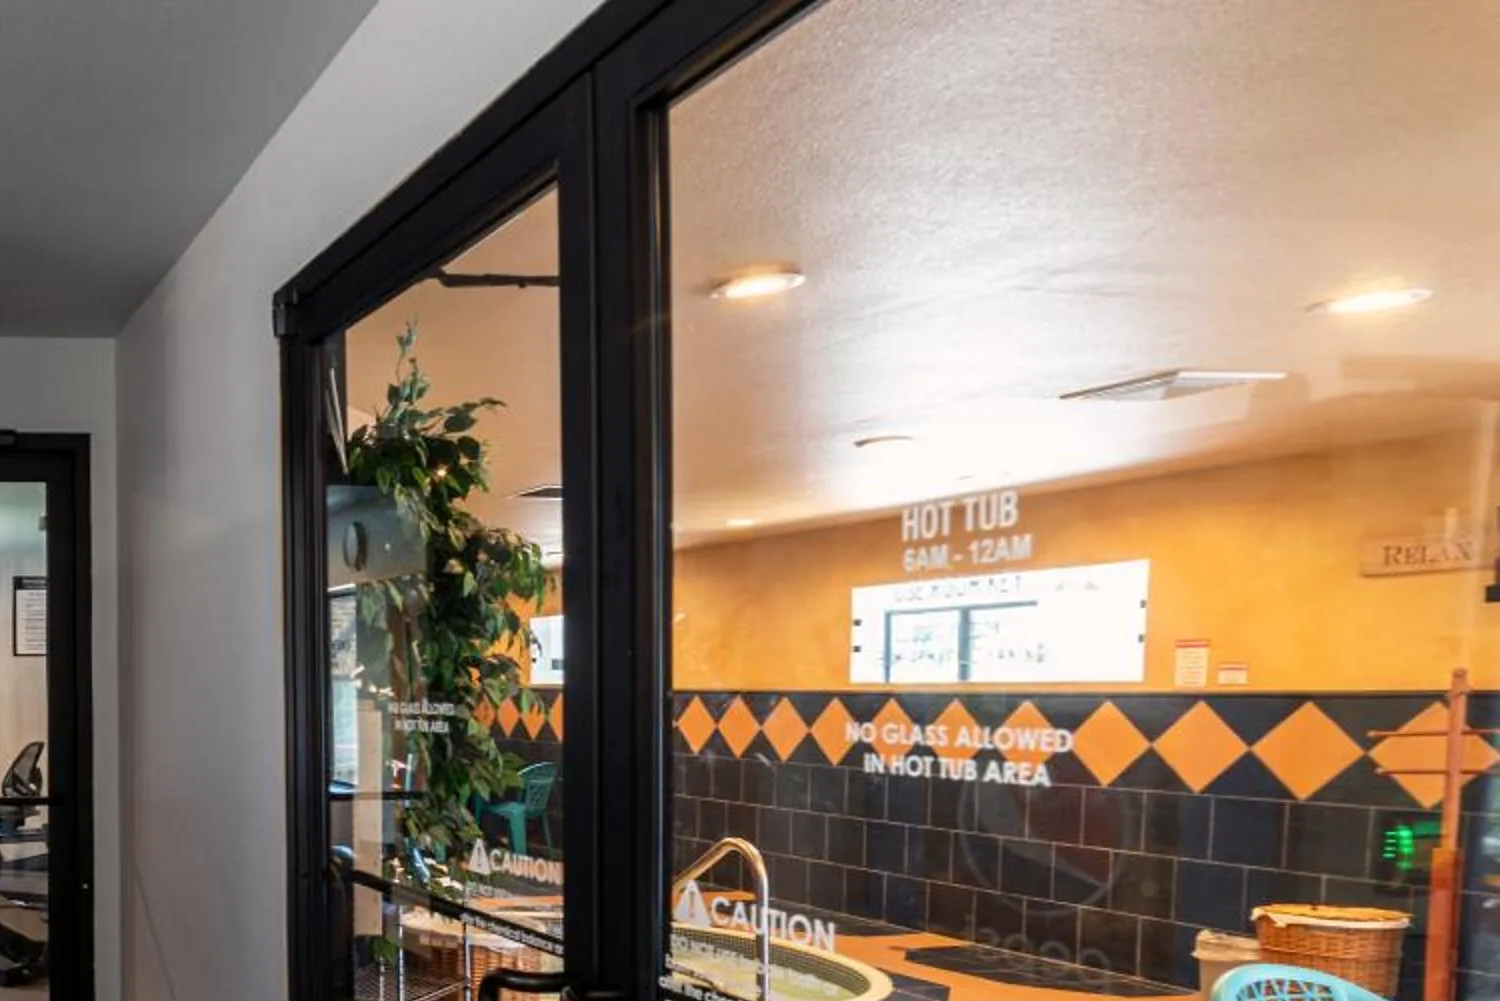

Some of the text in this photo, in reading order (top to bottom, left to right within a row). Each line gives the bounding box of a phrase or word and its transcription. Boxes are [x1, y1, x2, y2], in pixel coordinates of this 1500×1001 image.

[901, 490, 1019, 542] HOT TUB
[967, 534, 1033, 565] 12AM
[845, 721, 1073, 752] NO GLASS ALLOWED
[863, 752, 1051, 786] IN HOT TUB AREA
[490, 849, 564, 885] CAUTION
[712, 896, 836, 951] CAUTION
